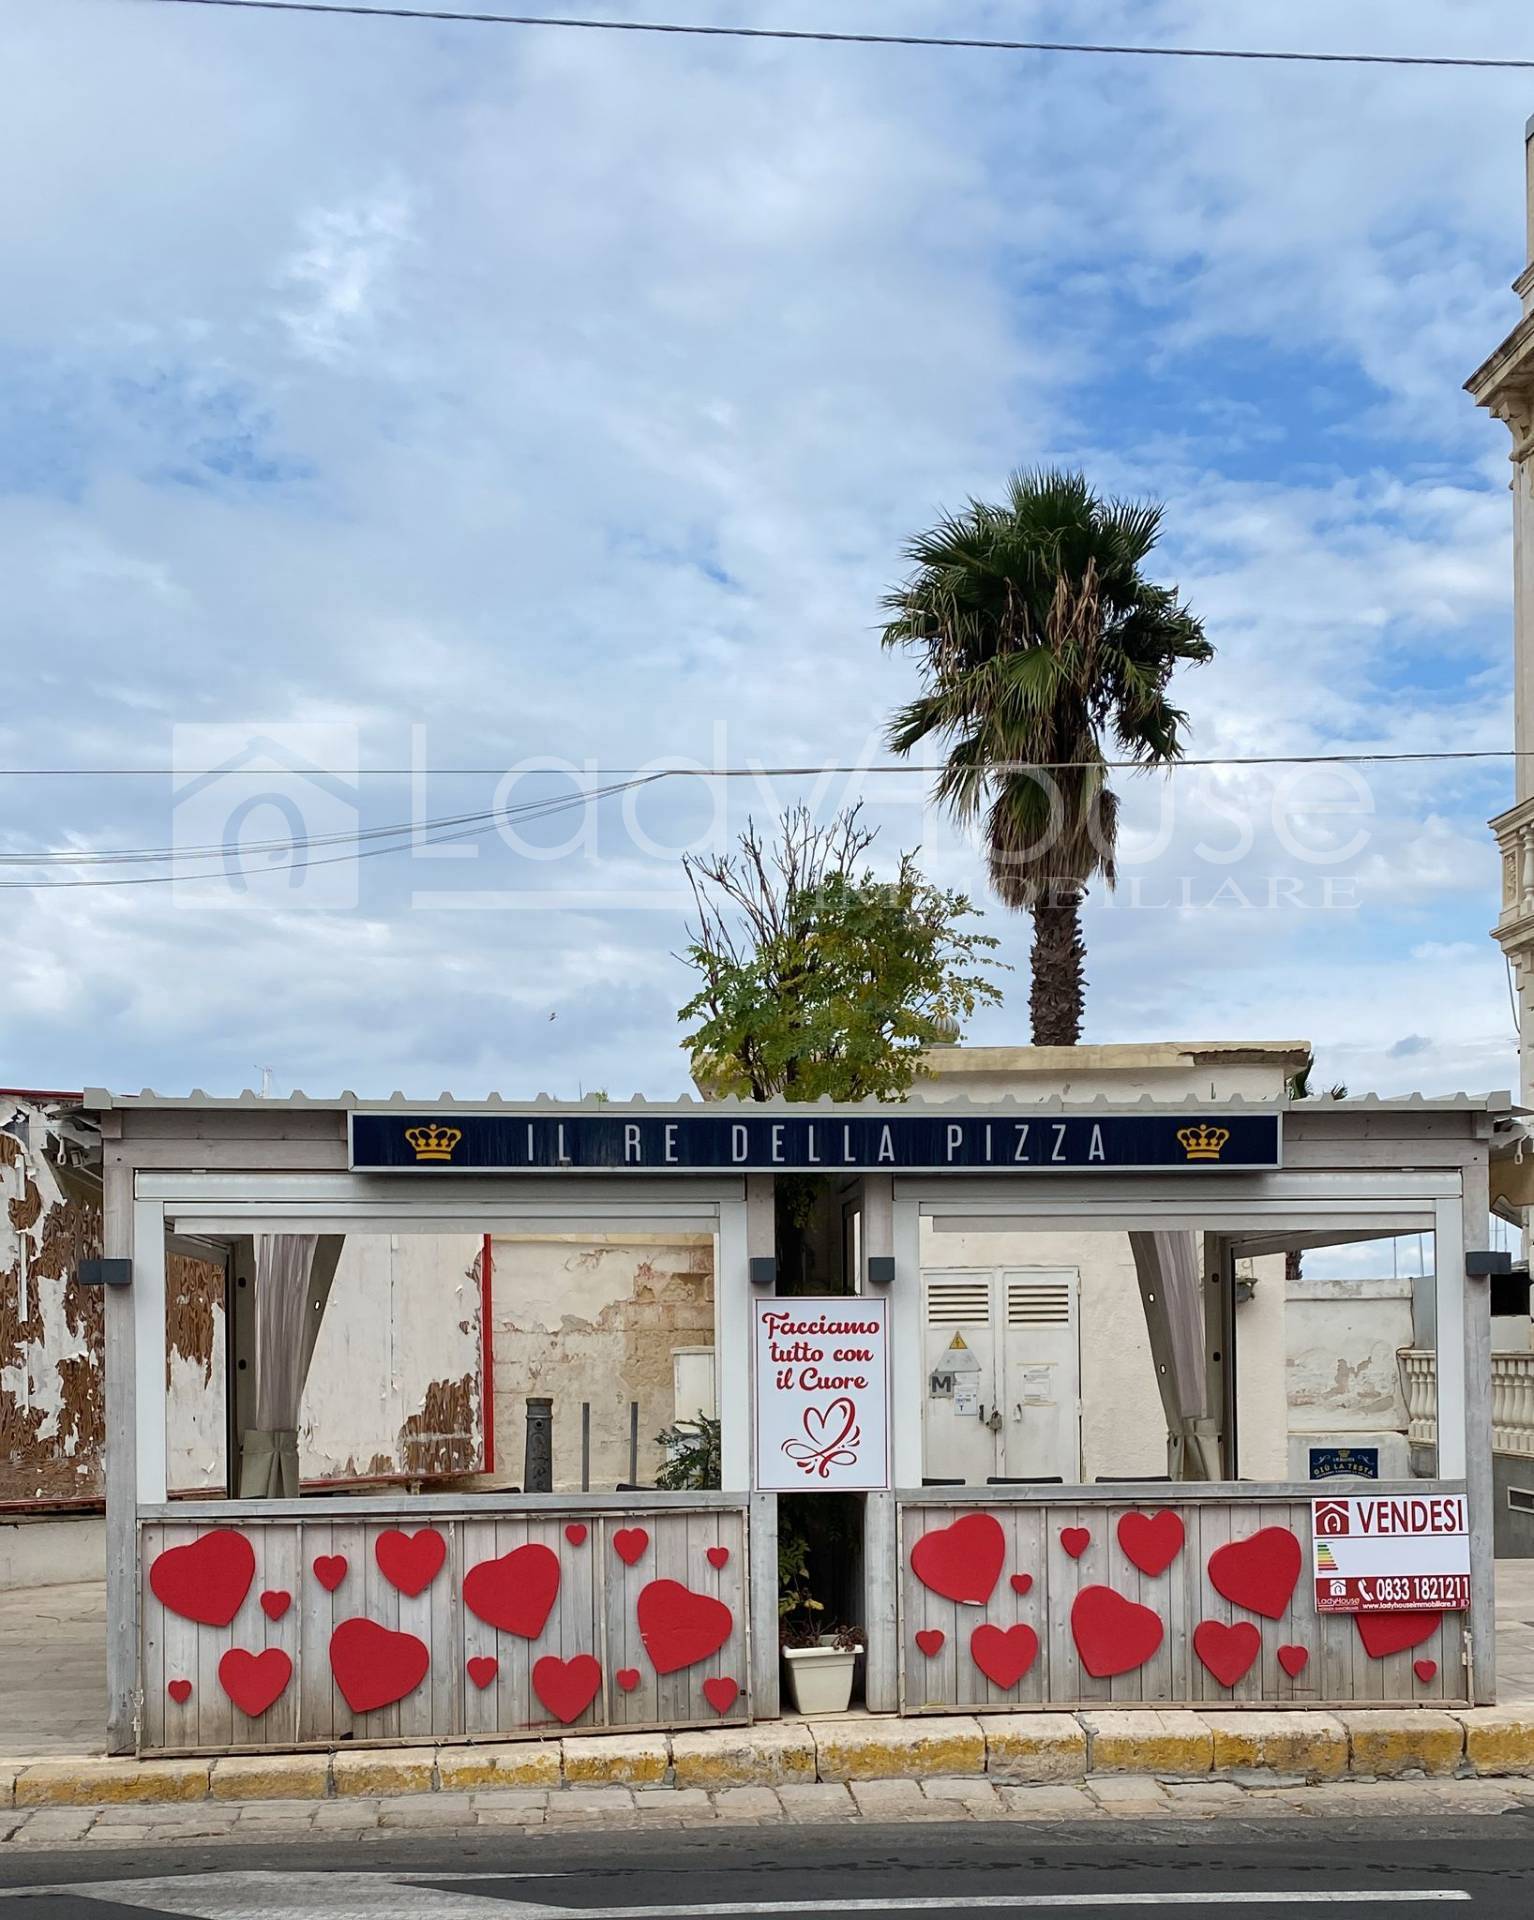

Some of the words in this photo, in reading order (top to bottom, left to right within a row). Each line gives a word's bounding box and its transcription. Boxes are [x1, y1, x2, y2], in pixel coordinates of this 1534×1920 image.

[525, 1124, 573, 1163] IL
[626, 1124, 681, 1163] RE
[732, 1124, 896, 1162] DELLA
[947, 1124, 1107, 1162] PIZZA
[762, 1312, 880, 1339] Facciamo
[769, 1341, 824, 1362] tutto
[833, 1348, 874, 1362] con
[776, 1367, 795, 1390] il
[799, 1367, 868, 1391] Cuore
[931, 1375, 952, 1393] M
[1347, 1463, 1374, 1476] TESTA
[1357, 1500, 1463, 1532] VENDESI
[1376, 1578, 1410, 1601] 0833
[1414, 1576, 1470, 1600] 1821211
[1362, 1600, 1457, 1610] www.ladyhouseimmobiliare.it
